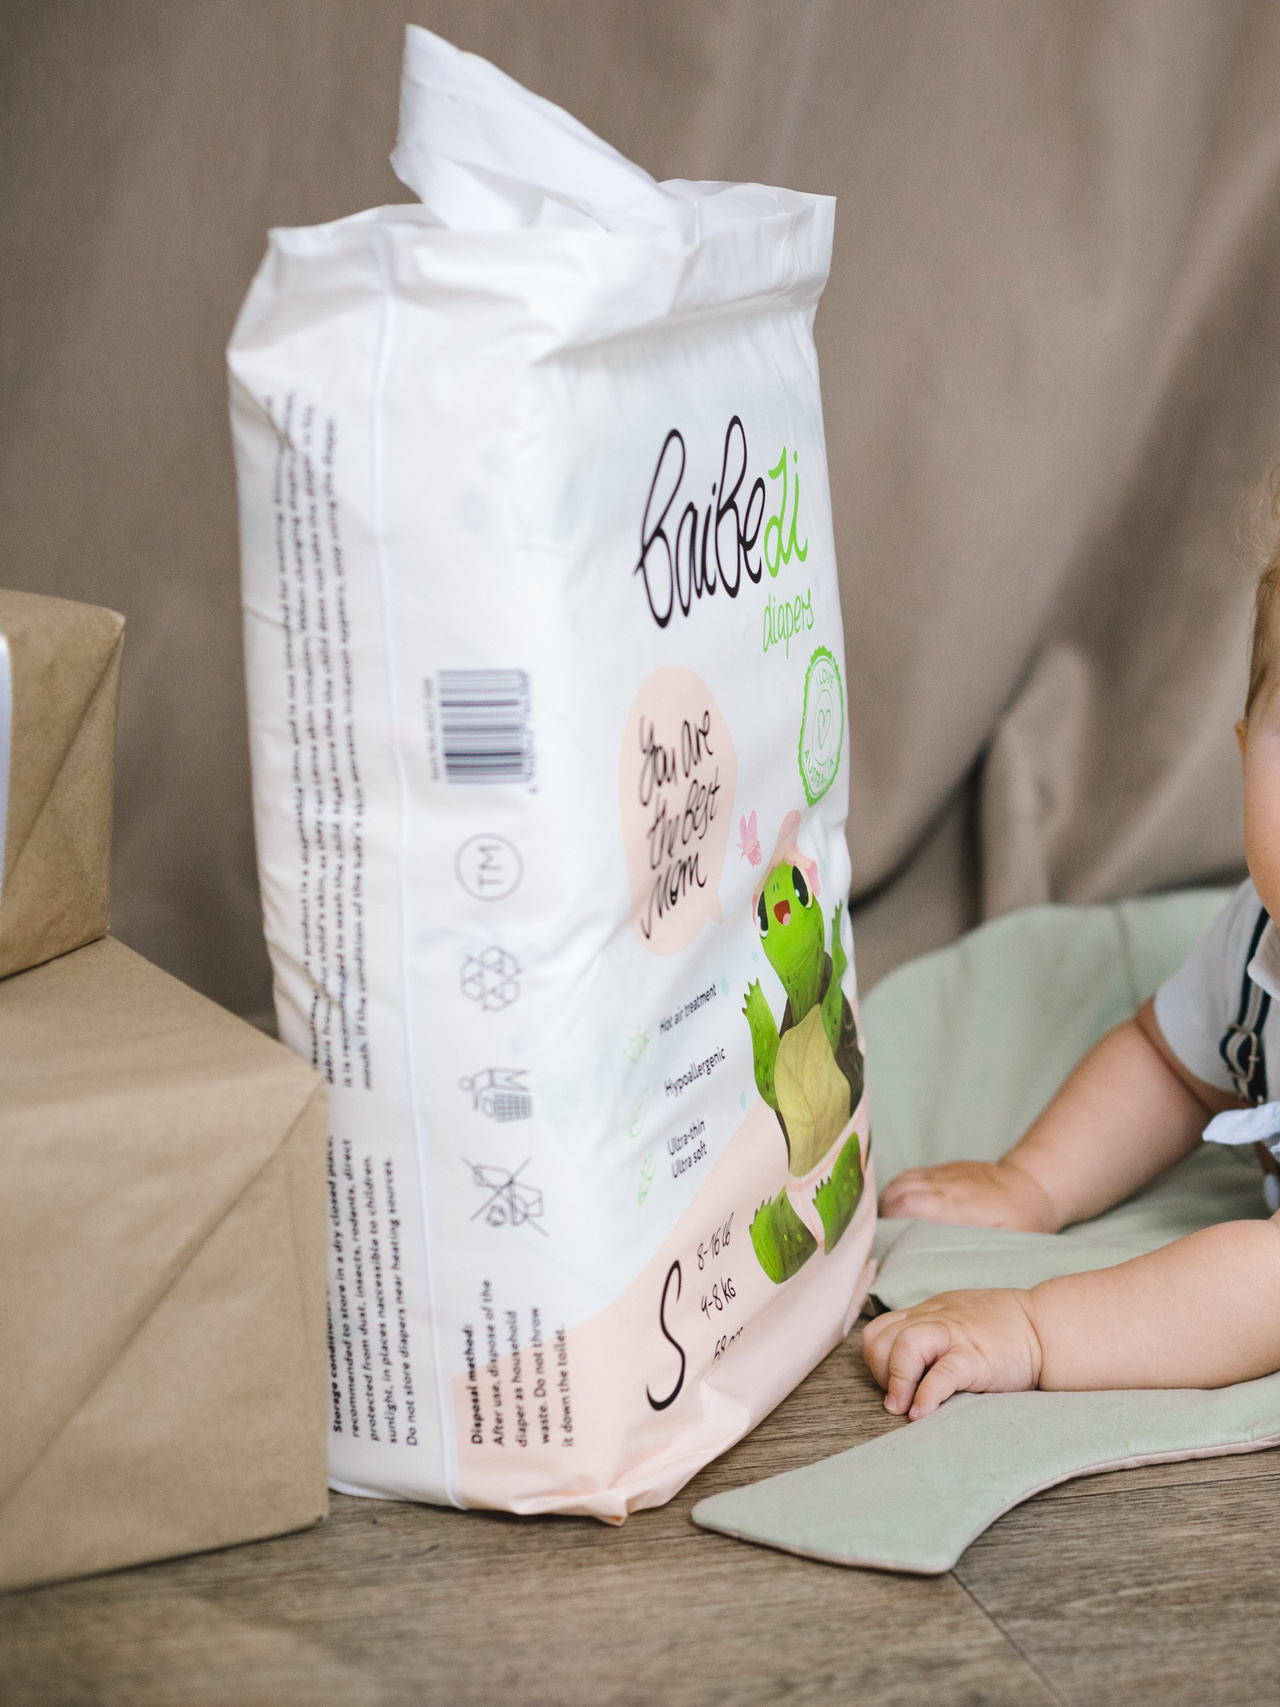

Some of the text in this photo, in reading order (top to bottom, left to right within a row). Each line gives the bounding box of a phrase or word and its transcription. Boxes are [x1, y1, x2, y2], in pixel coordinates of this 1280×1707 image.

[763, 588, 814, 659] diapers
[819, 668, 834, 690] LOVE
[639, 710, 713, 807] You are
[477, 844, 502, 892] TM
[659, 983, 717, 1035] Hot air treatment
[664, 1046, 726, 1098] Hypoallergenic
[667, 1118, 706, 1156] Ultra-thin
[672, 1140, 708, 1179] Ultra soft
[332, 1232, 343, 1253] dry
[368, 1221, 378, 1234] to
[334, 1268, 345, 1280] in
[338, 1285, 348, 1319] store
[701, 1282, 723, 1321] 4-8
[341, 1323, 351, 1337] to
[378, 1323, 393, 1366] places
[397, 1309, 409, 1358] diapers
[646, 1259, 686, 1411] S
[361, 1340, 372, 1371] from
[532, 1352, 543, 1374] not
[341, 1340, 360, 1438] recommended
[380, 1370, 391, 1381] in
[402, 1363, 413, 1395] store
[503, 1311, 529, 1447] diaper as household
[534, 1379, 546, 1398] Do
[556, 1371, 569, 1392] the
[330, 1382, 343, 1433] Storage
[363, 1375, 380, 1442] protected
[405, 1401, 415, 1423] not
[466, 1386, 484, 1445] Disposal
[560, 1396, 573, 1433] down
[406, 1427, 418, 1446] Do
[491, 1411, 505, 1446] After
[561, 1438, 573, 1447] it
